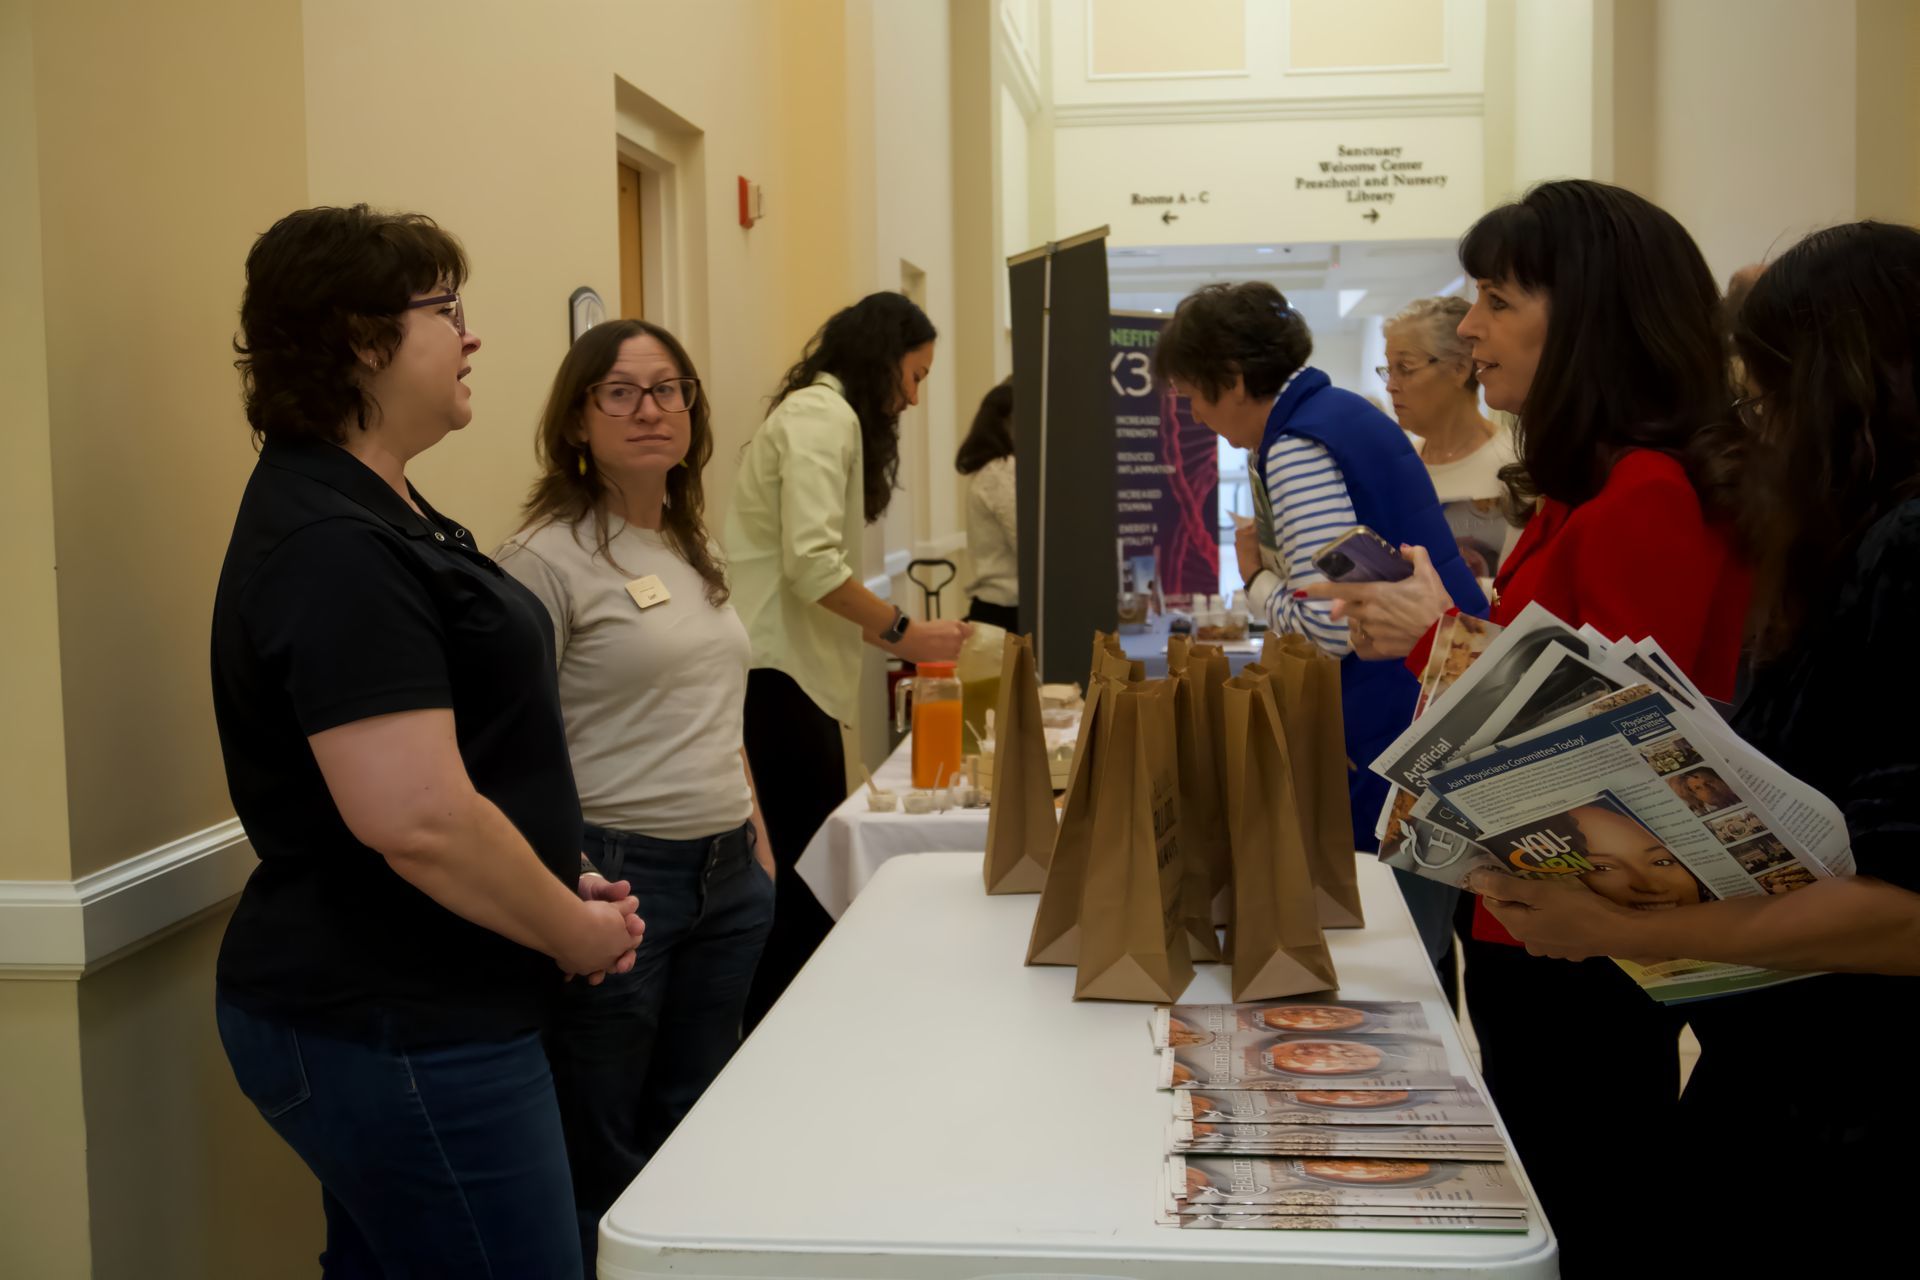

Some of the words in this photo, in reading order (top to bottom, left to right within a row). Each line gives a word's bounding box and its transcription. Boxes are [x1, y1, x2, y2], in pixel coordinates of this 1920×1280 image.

[1338, 145, 1402, 158] Sanctuary
[1319, 161, 1377, 173] Welcome
[1381, 159, 1422, 171] Center
[1296, 177, 1360, 190] Preschool
[1364, 176, 1389, 187] and
[1393, 174, 1447, 188] Nursery
[1131, 193, 1173, 205] Rooms
[1176, 193, 1187, 204] A
[1198, 191, 1210, 204] C
[1346, 190, 1394, 204] Library
[1110, 329, 1162, 347] NEFITS
[1116, 416, 1161, 425] INCREASED
[1116, 428, 1158, 438] STRENGTH
[1620, 711, 1660, 729] Physicians
[1623, 717, 1664, 737] Committee
[1403, 738, 1452, 783] Artificial
[1447, 777, 1466, 790] Join
[1465, 763, 1511, 783] Physicians
[1508, 746, 1557, 768] Committee
[1555, 735, 1587, 752] Today!
[1231, 1160, 1256, 1192] HEALTH
